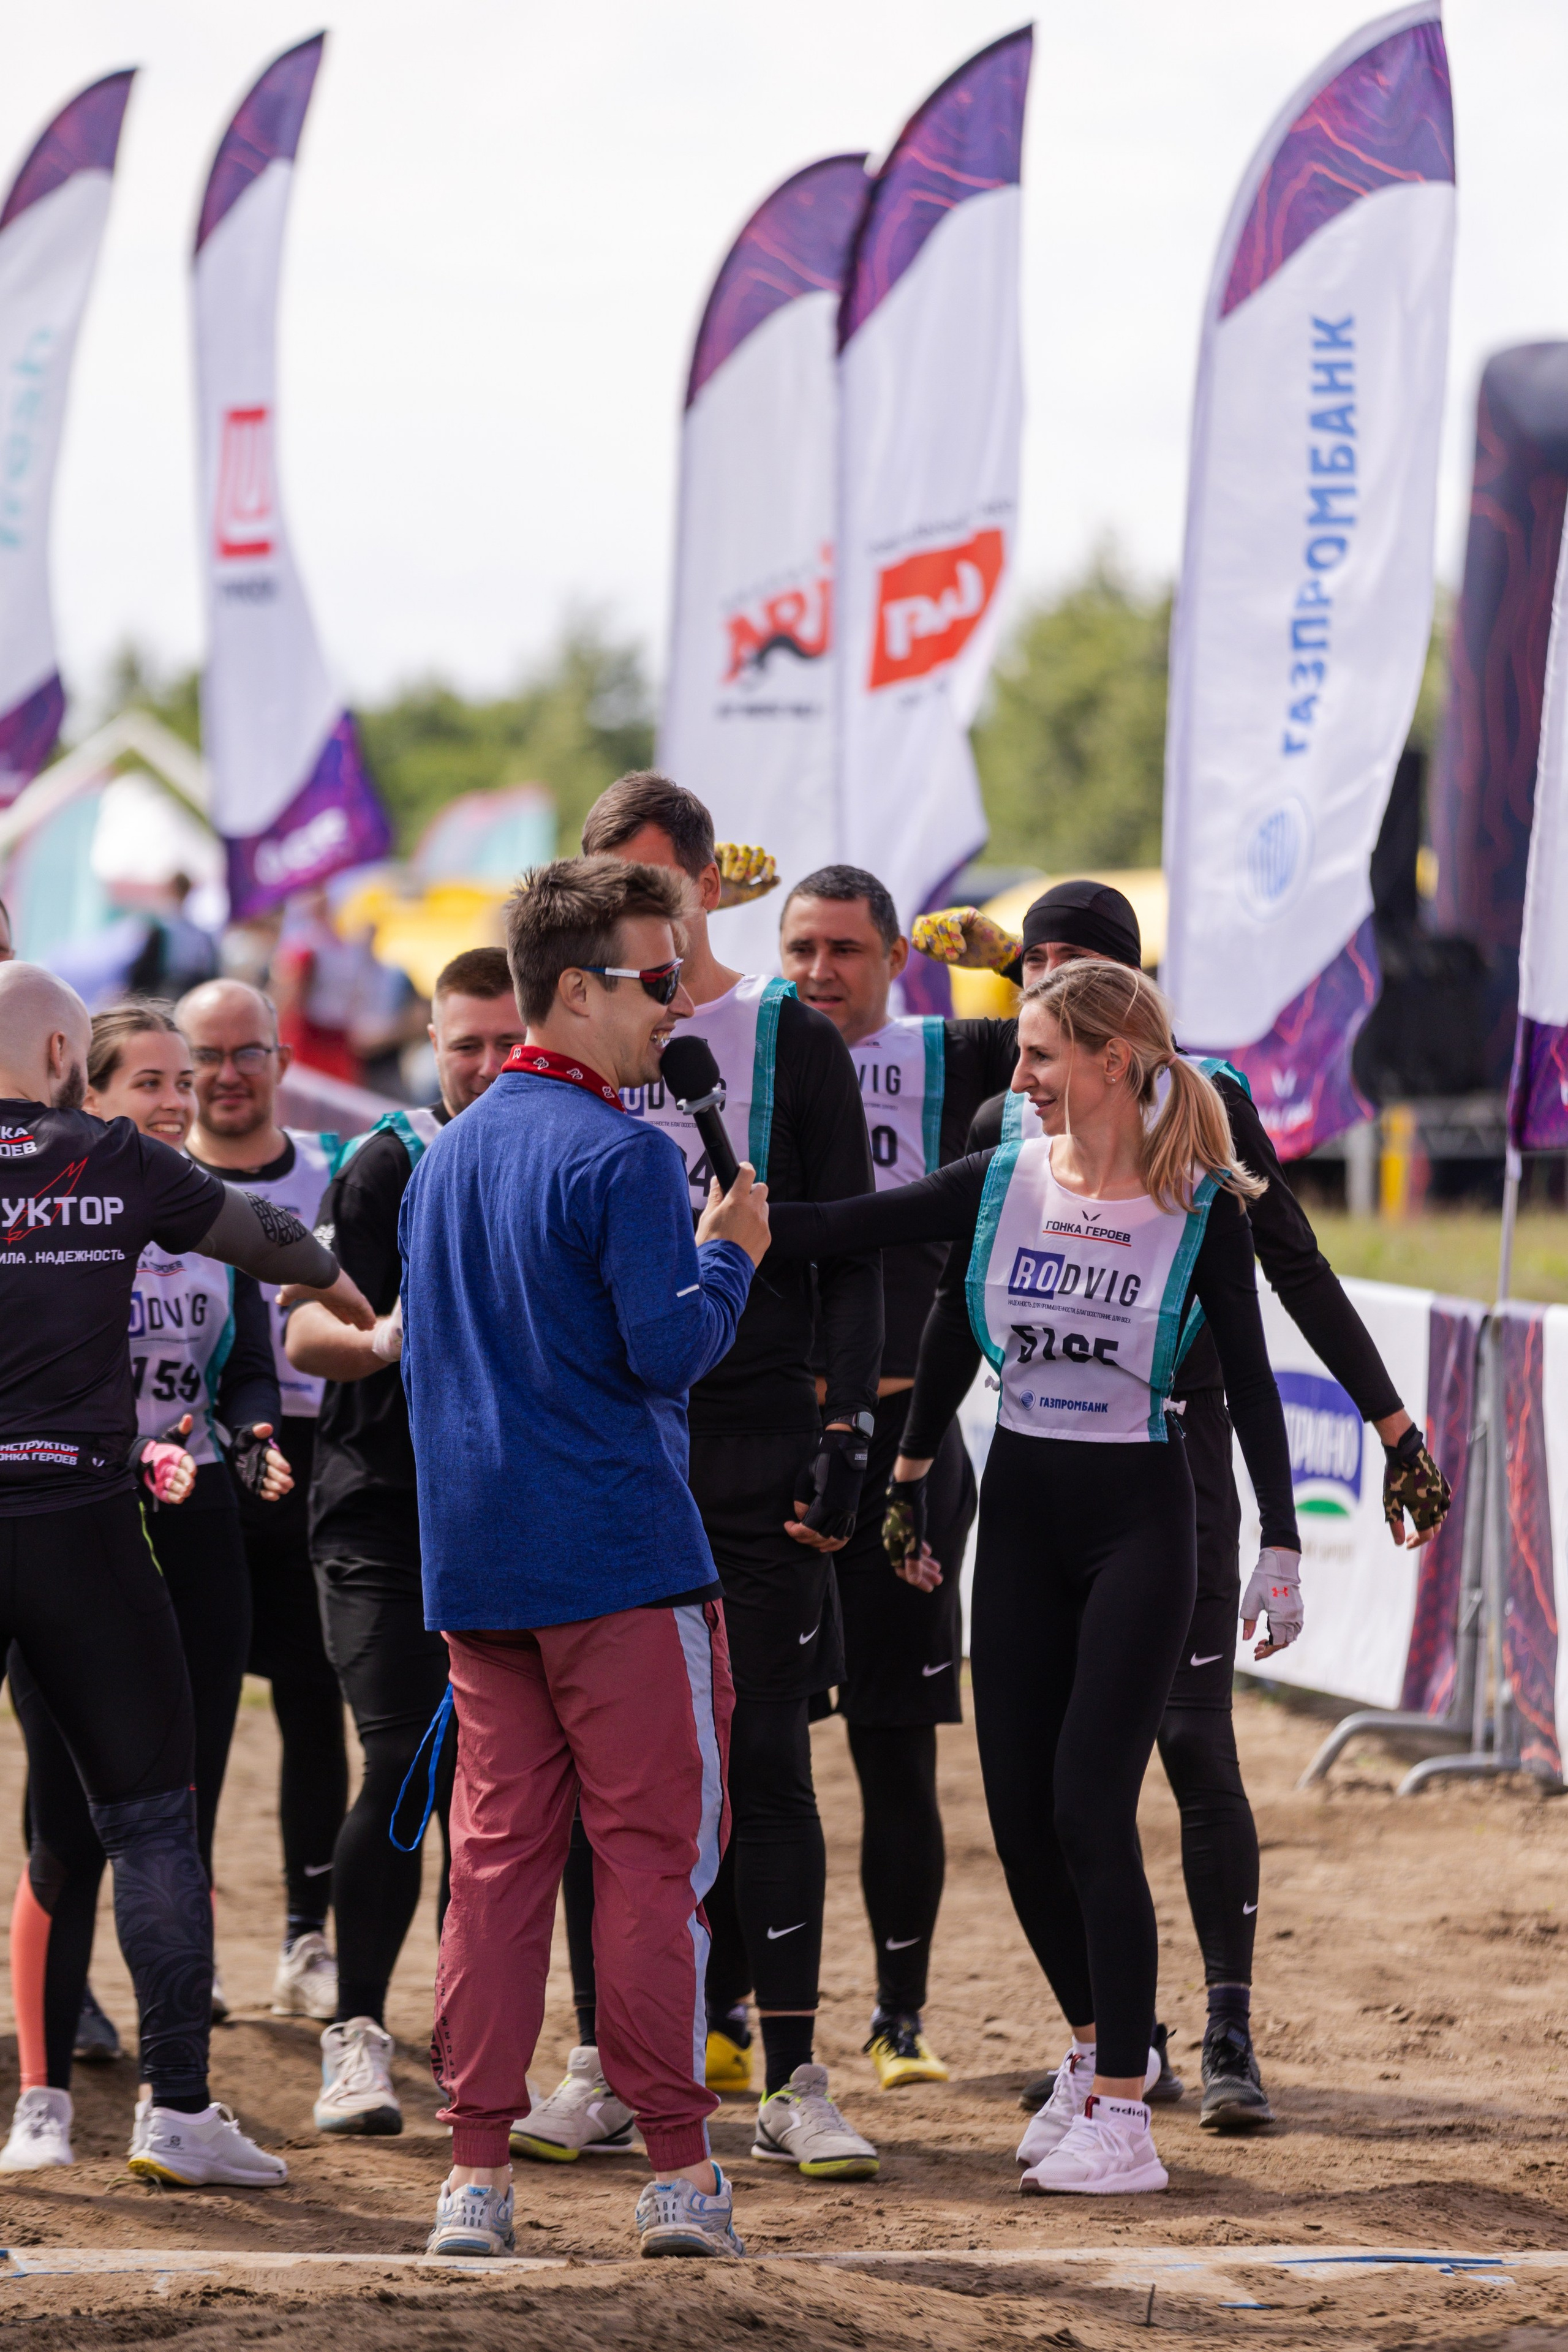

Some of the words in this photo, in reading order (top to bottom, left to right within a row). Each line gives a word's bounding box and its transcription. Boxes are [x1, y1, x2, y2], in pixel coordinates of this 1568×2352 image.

[1284, 315, 1356, 753] ГАЗПРОМБАНК
[1046, 1221, 1082, 1234] ГОНКА
[1085, 1226, 1131, 1243] ГЕРОЕВ
[36, 1250, 126, 1265] НАДЕЖНОСТЬ
[1012, 1255, 1142, 1307] RODVIG
[1008, 1299, 1032, 1308] НАДЕЖНОСТЬ
[1039, 1396, 1109, 1413] ГАЗПРОМБАНК
[32, 1452, 77, 1465] ГЕРОЕВ
